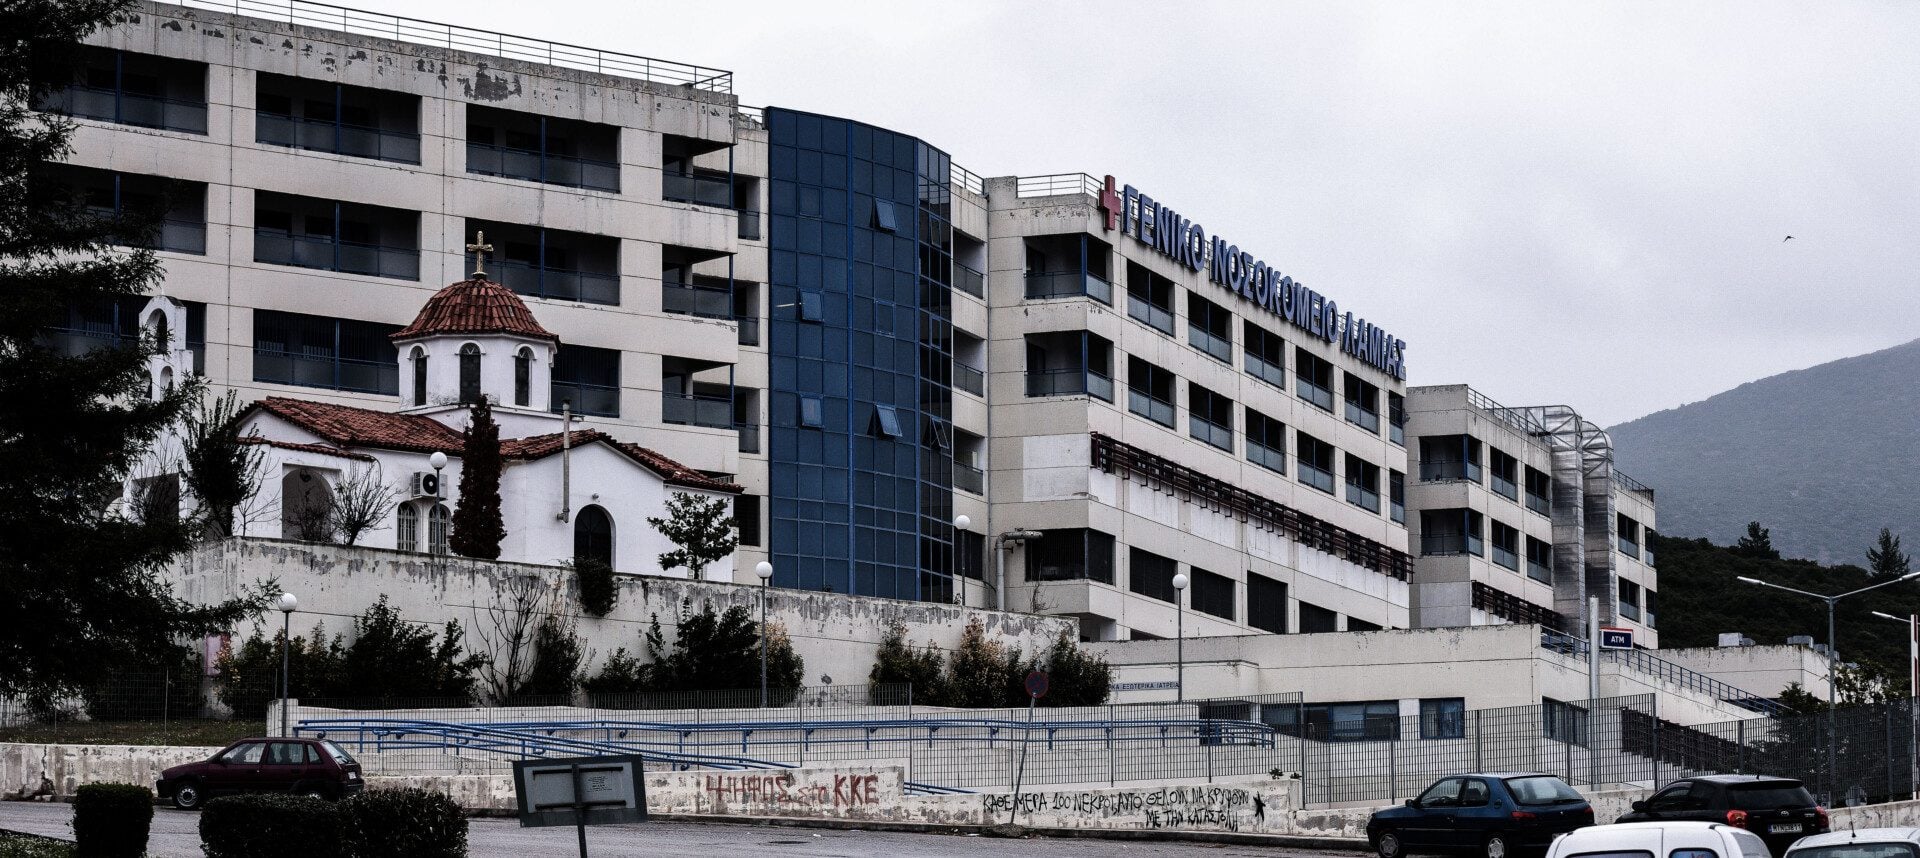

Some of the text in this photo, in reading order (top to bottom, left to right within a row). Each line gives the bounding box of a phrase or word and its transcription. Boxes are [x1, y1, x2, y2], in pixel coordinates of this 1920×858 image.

[1123, 184, 1407, 381] ΓΕΝΙΚΟ ΝΟΣΟΚΟΜΕΙΟ ΛΑΜΙΑΣ
[1122, 682, 1154, 690] ΕΞΩΤΕΡΙΚΑ
[834, 774, 879, 807] ΚΚΕ
[983, 793, 1013, 813] ΚΑΘΕ
[1015, 792, 1047, 813] ΜΕΡΑ
[1052, 792, 1070, 810] 100
[1146, 788, 1188, 806] ΘΕΛΟΥΝ
[1191, 786, 1205, 804] ΝΑ
[1145, 808, 1239, 832] ΜΕ ΤΗΝ ΚΑΤΑΣΤΟΛΗ
